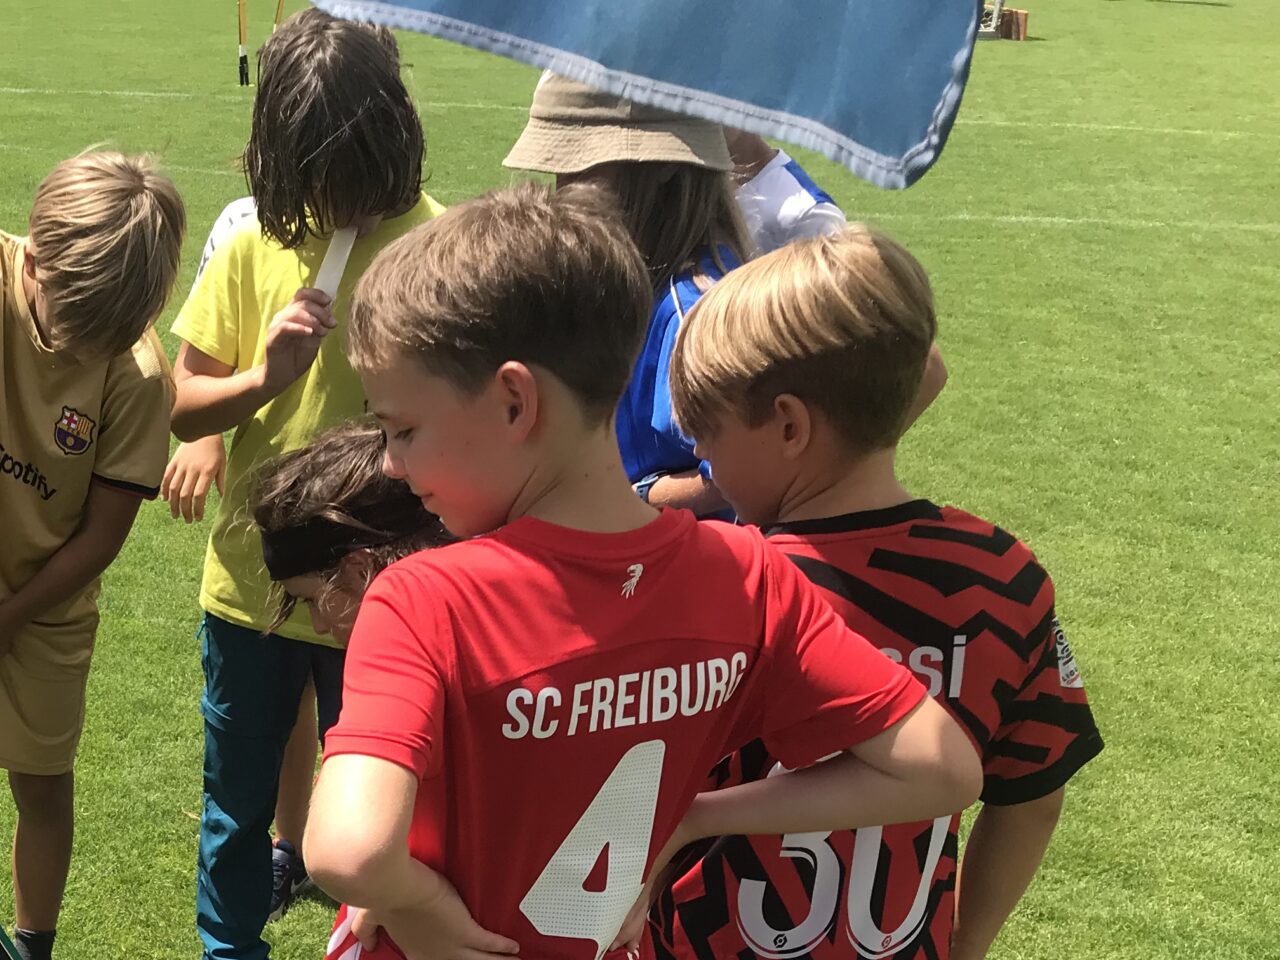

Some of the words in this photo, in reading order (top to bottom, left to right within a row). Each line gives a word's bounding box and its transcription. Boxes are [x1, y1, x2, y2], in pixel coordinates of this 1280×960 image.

[502, 687, 562, 739] SC
[567, 652, 747, 736] FREIBURG
[736, 752, 953, 960] 30
